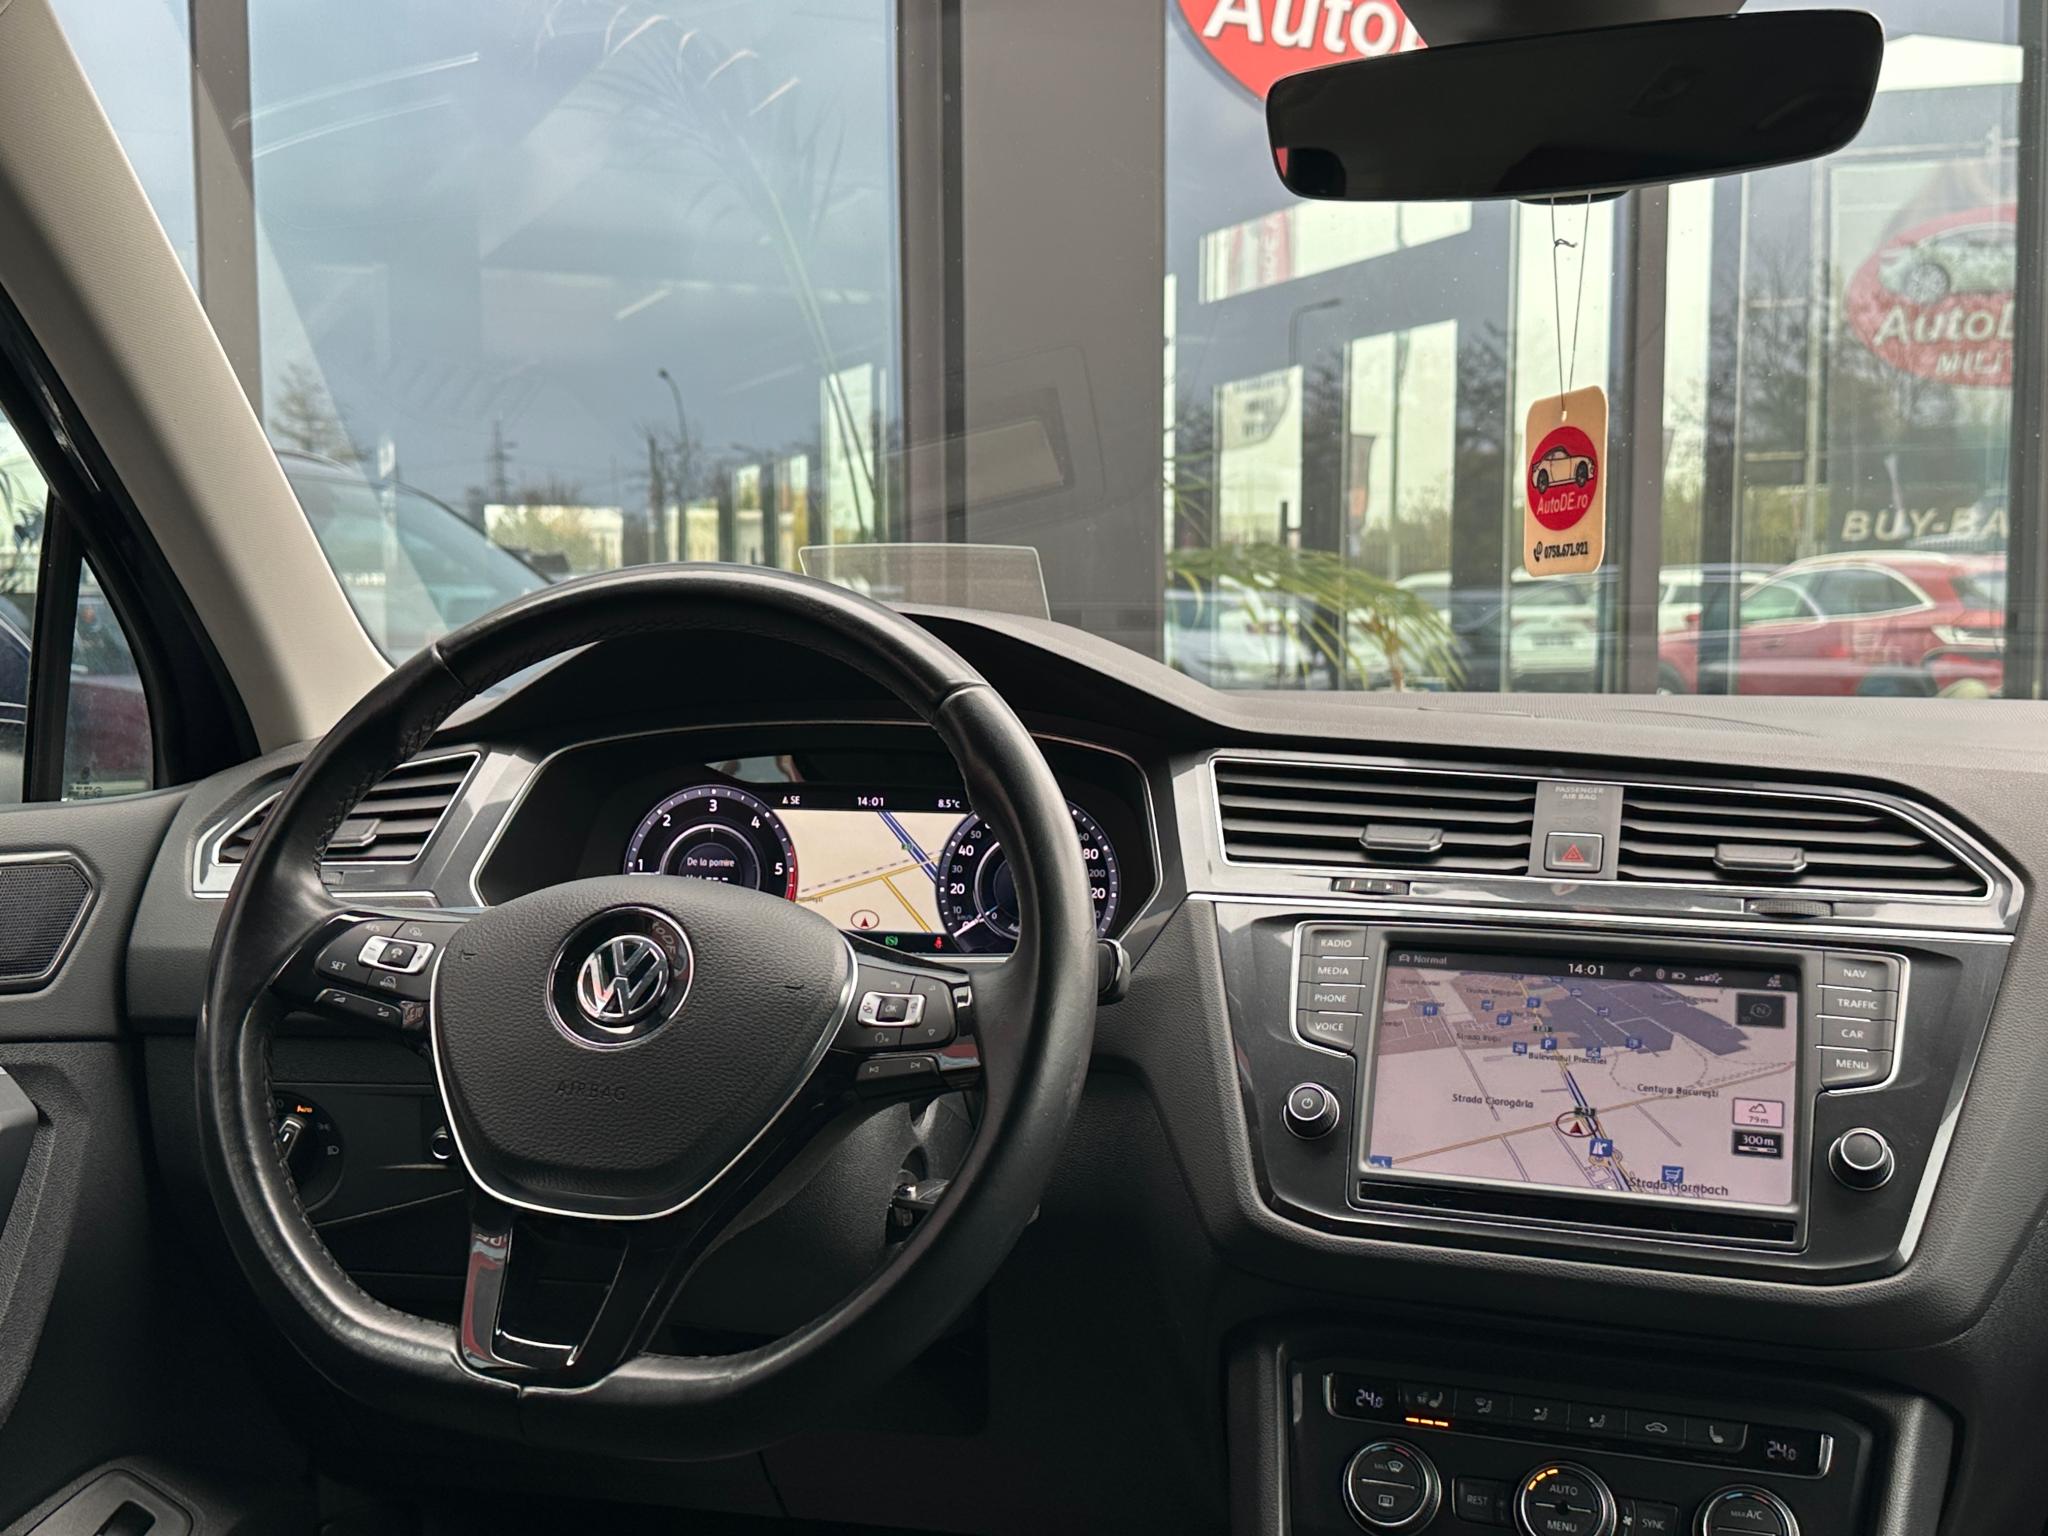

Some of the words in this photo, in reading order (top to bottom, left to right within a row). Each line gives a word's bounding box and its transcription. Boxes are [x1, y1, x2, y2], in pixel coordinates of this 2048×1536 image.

[1203, 0, 1421, 57] Auto
[1536, 491, 1589, 515] AutoDE.ro
[1555, 786, 1604, 795] PASSENGER
[709, 800, 718, 812] 3
[857, 796, 884, 807] 14:01
[662, 815, 671, 827] 2
[751, 816, 761, 829] 4
[970, 830, 982, 840] 50
[958, 844, 974, 857] 40
[637, 858, 644, 871] 1
[774, 863, 783, 875] 5
[951, 864, 963, 874] 30
[1089, 868, 1106, 878] 200
[950, 883, 965, 895] 20
[1320, 939, 1352, 949] RADIO
[331, 961, 347, 970] SET
[1414, 954, 1447, 966] Normal
[1317, 966, 1349, 977] MEDIA
[1567, 963, 1606, 976] 14:01
[1843, 968, 1867, 979] NAV
[1314, 993, 1347, 1004] PHONE
[1837, 998, 1878, 1010] TRAFFIC
[1314, 1021, 1344, 1032] VOICE
[1841, 1029, 1864, 1040] CAR
[1835, 1059, 1869, 1070] MENU
[554, 1079, 626, 1102] AIRBAG
[1452, 1093, 1482, 1105] Strada
[1629, 1175, 1667, 1191] Strada
[1549, 1483, 1578, 1496] AUTO
[1466, 1494, 1488, 1506] REST
[1546, 1519, 1577, 1533] MENU
[1641, 1518, 1664, 1530] SYNC
